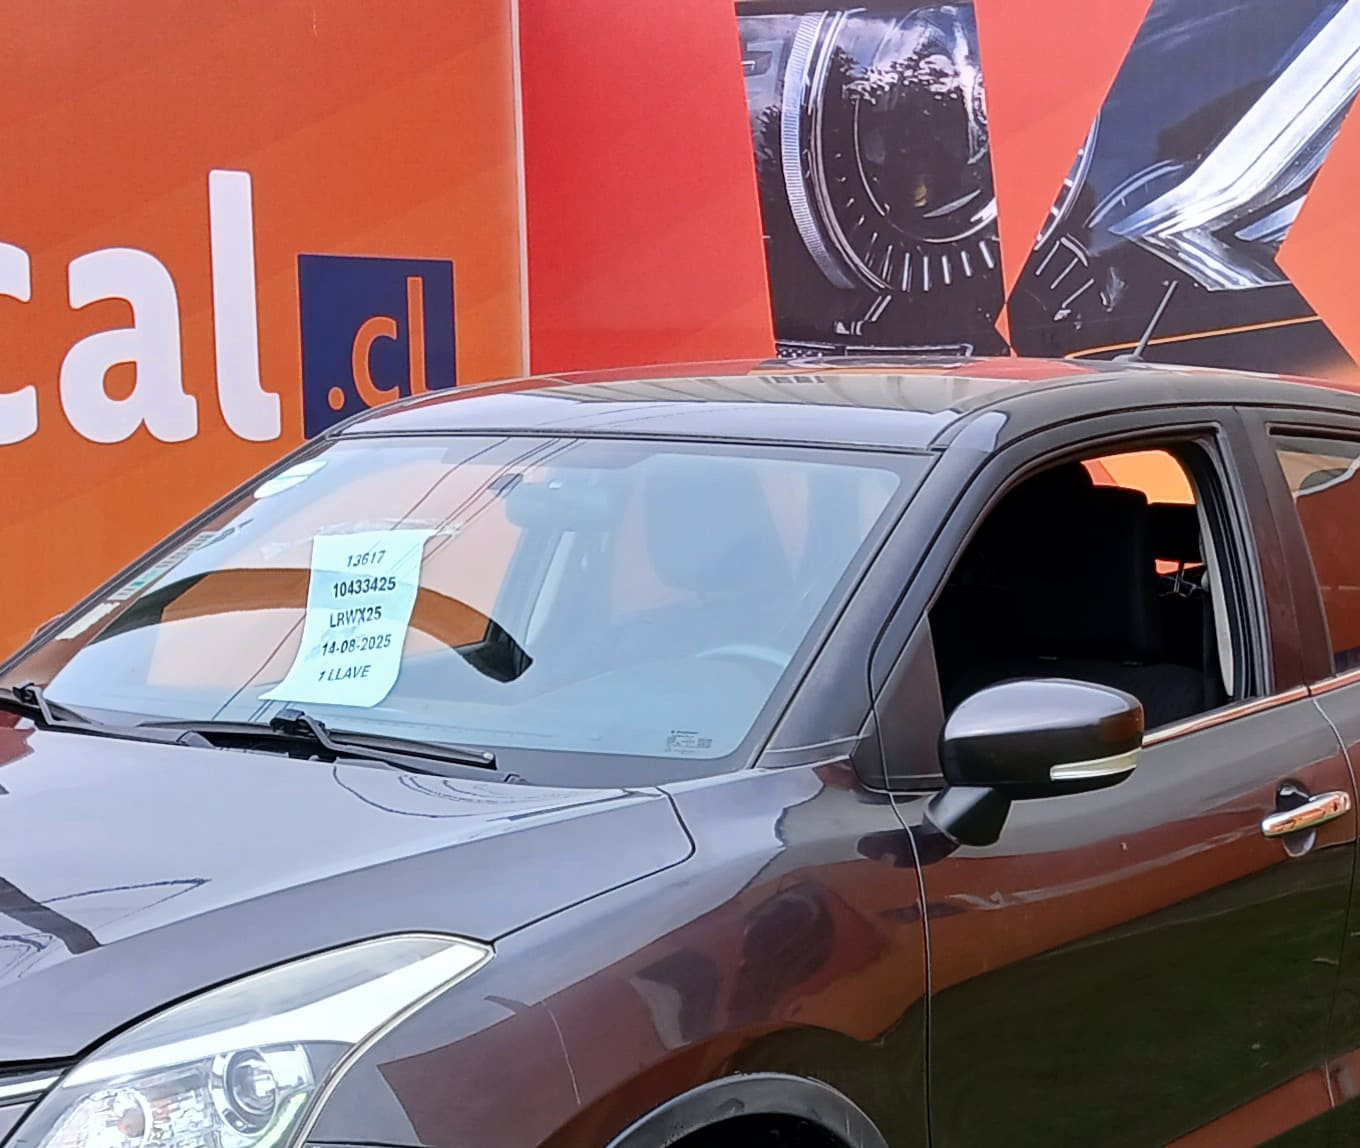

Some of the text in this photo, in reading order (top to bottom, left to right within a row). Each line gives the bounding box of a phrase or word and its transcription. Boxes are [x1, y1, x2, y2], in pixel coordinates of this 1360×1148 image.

[346, 549, 386, 567] 13617
[333, 576, 396, 599] 10433425
[329, 605, 382, 629] LRWX25
[322, 633, 392, 656] 14-08-2025
[327, 664, 372, 681] LLAVE
